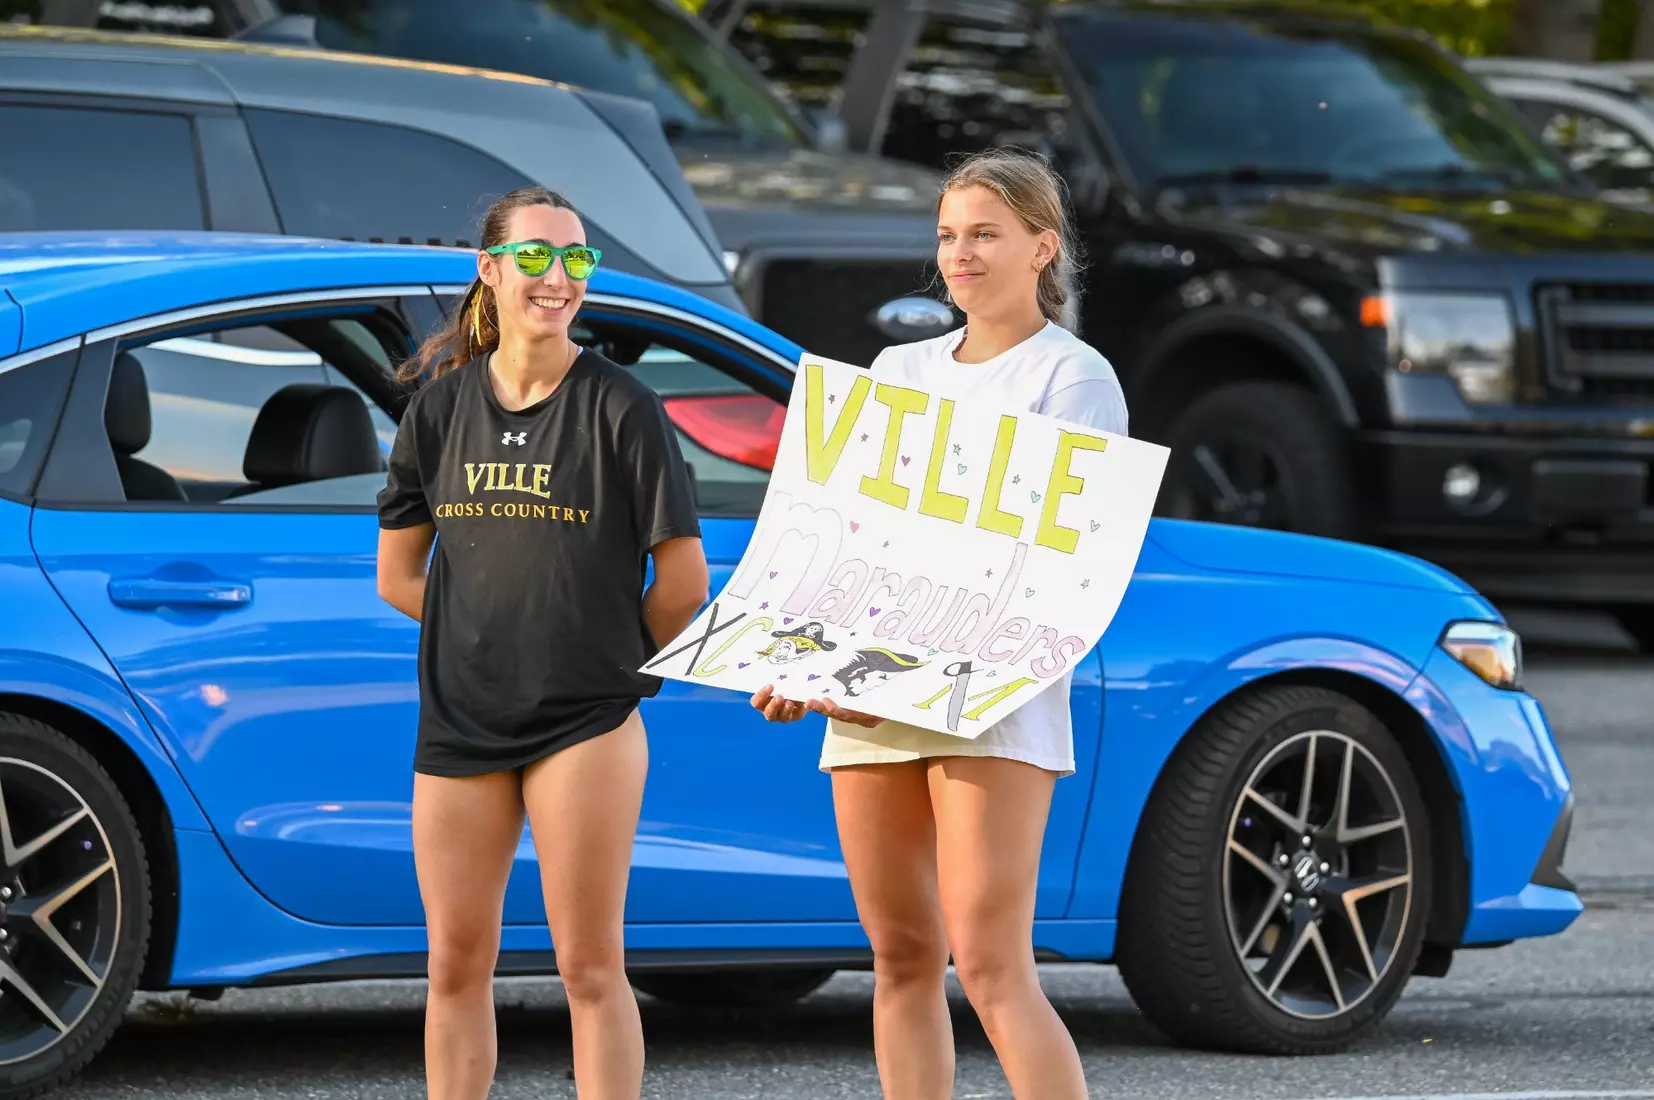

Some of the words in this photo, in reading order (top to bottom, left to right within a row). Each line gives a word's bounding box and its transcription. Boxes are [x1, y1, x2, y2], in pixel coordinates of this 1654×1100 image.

[464, 463, 552, 499] VILLE
[804, 364, 1108, 554] VILLE
[436, 502, 484, 518] CROSS
[490, 503, 590, 523] COUNTRY
[727, 490, 1086, 679] Marauders
[645, 602, 774, 677] XC
